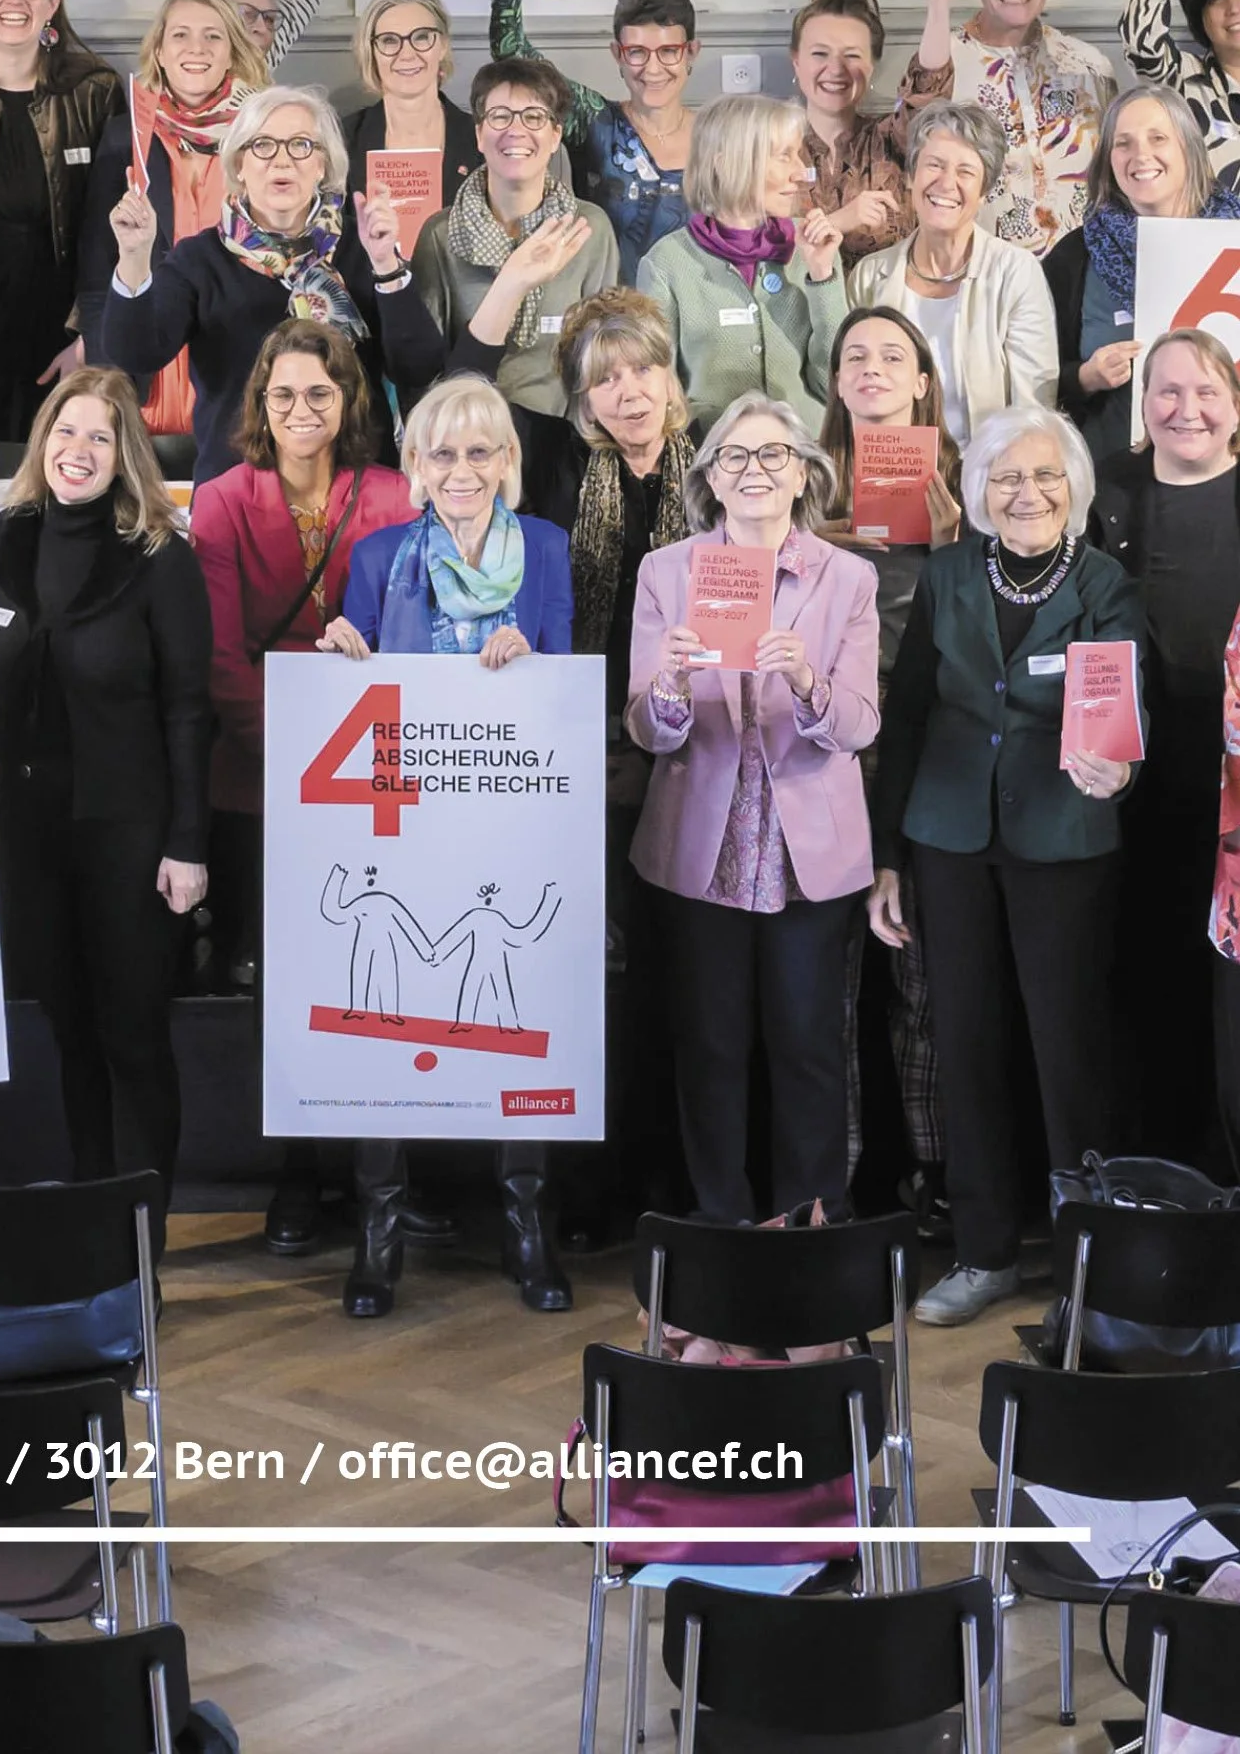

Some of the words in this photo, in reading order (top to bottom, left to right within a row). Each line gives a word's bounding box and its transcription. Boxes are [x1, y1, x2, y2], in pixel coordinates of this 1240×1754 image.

[371, 722, 517, 741] RECHTLICHE
[300, 684, 420, 837] 4
[371, 749, 540, 767] ABSICHERUNG
[545, 749, 555, 767] /
[371, 775, 472, 793] GLEICHE
[477, 775, 571, 794] RECHTE
[508, 1095, 559, 1110] alliance
[561, 1097, 570, 1110] F
